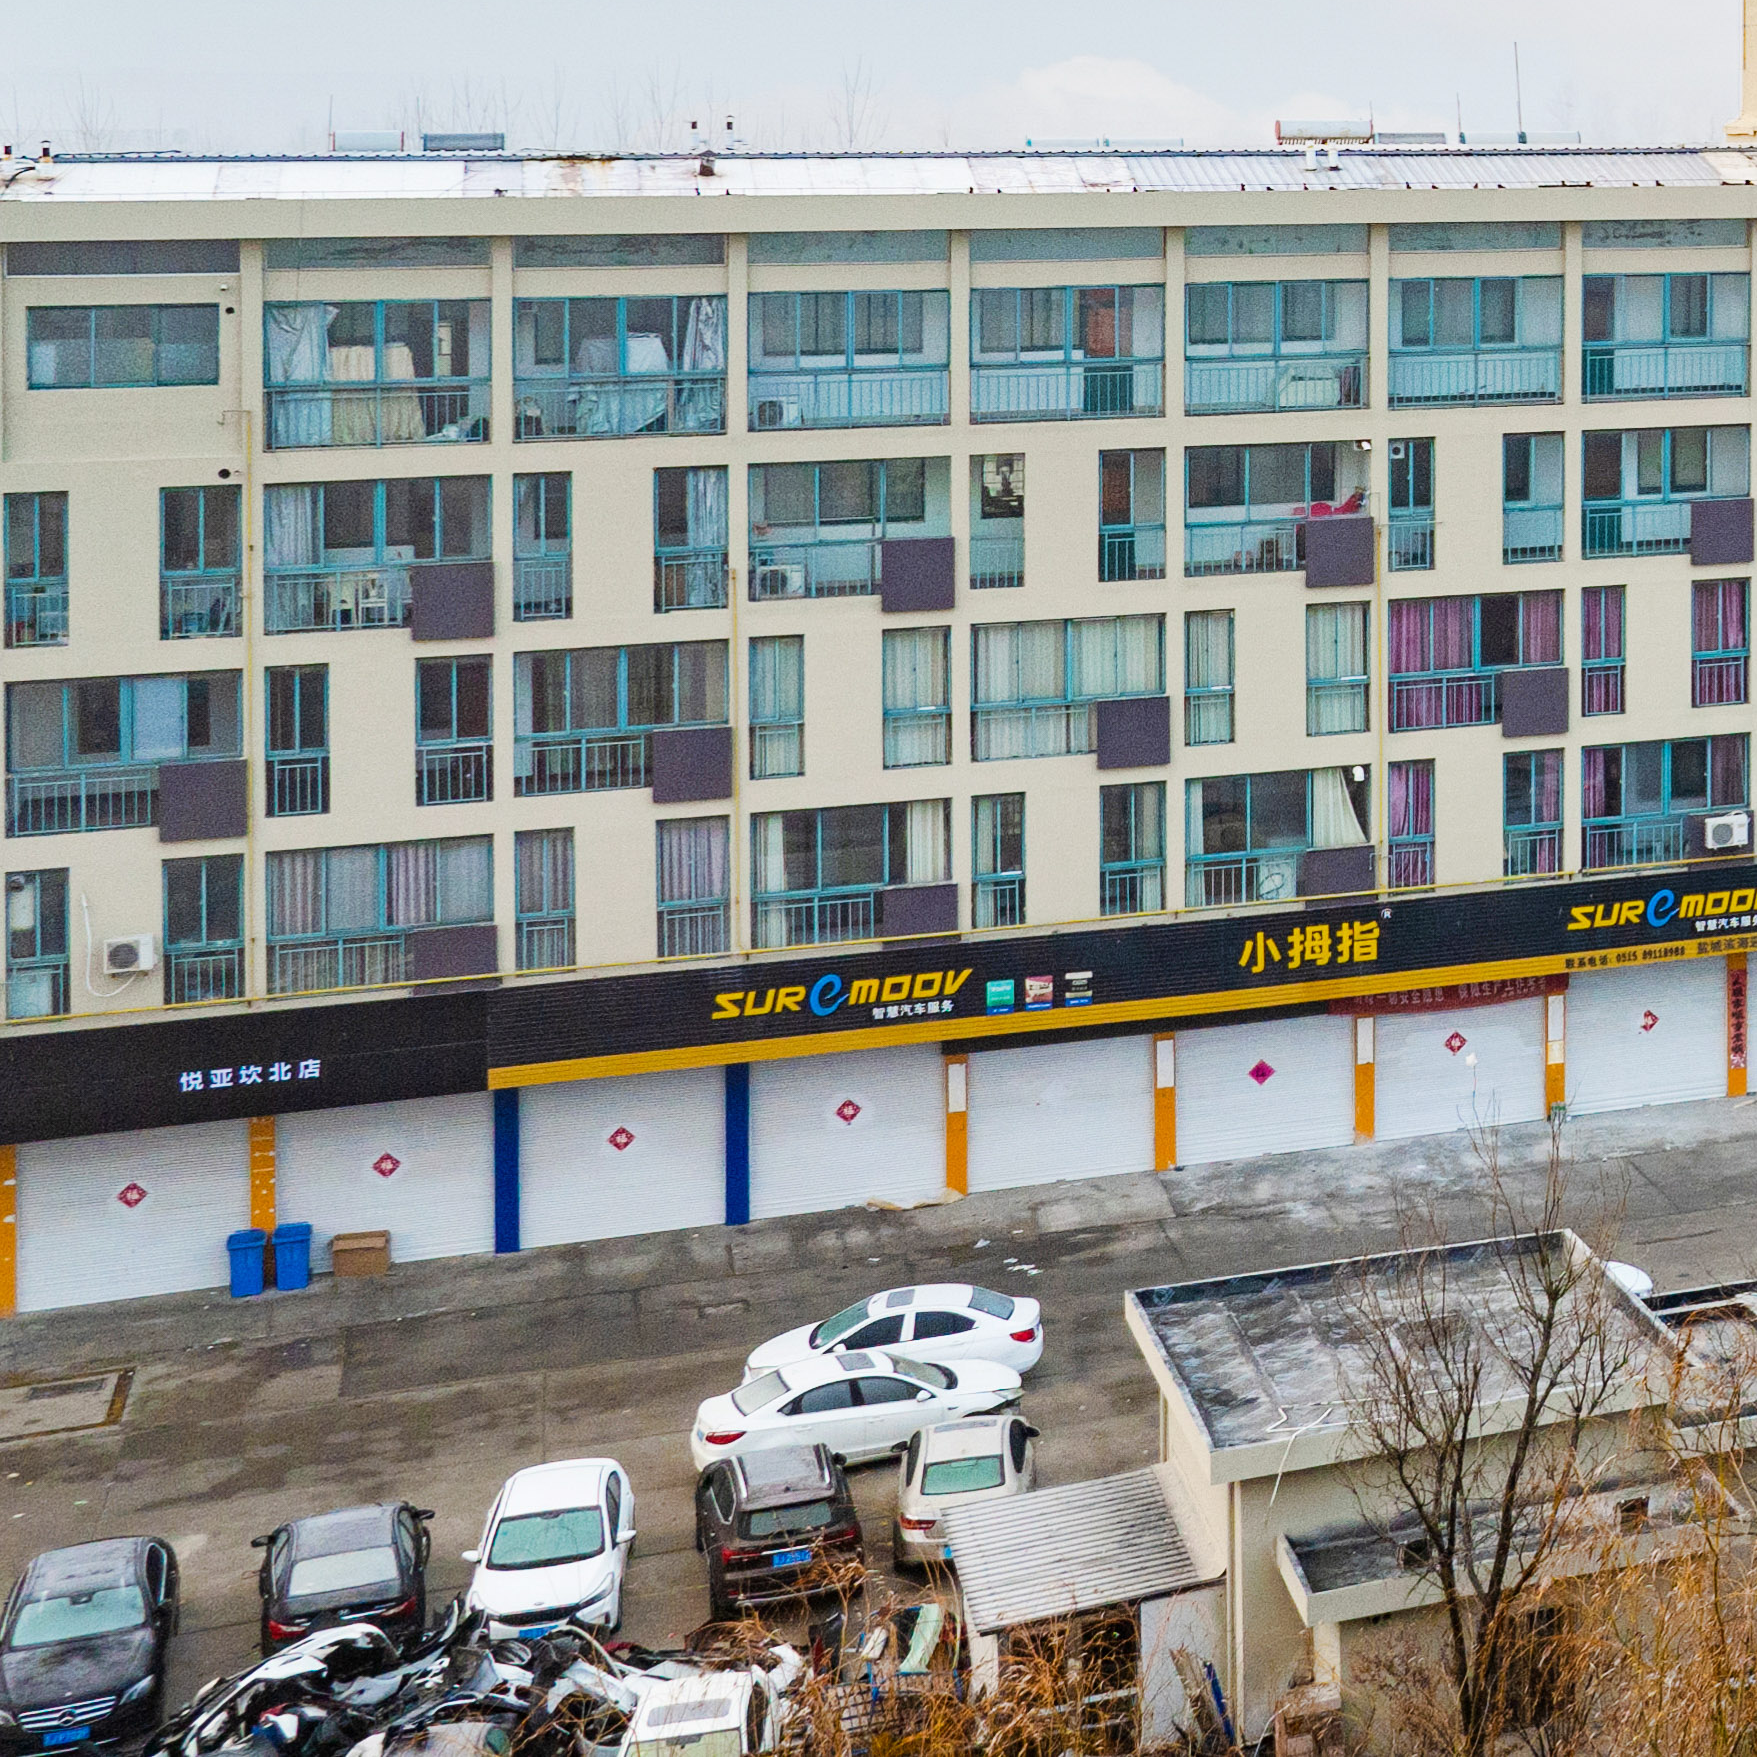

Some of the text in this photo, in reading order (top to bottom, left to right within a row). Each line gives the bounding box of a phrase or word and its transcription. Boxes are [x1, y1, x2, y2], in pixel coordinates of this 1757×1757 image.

[1239, 920, 1380, 974] 小拇指
[872, 1000, 955, 1020] 智慧汽车服务
[179, 1058, 321, 1092] 悦亚坎北店
